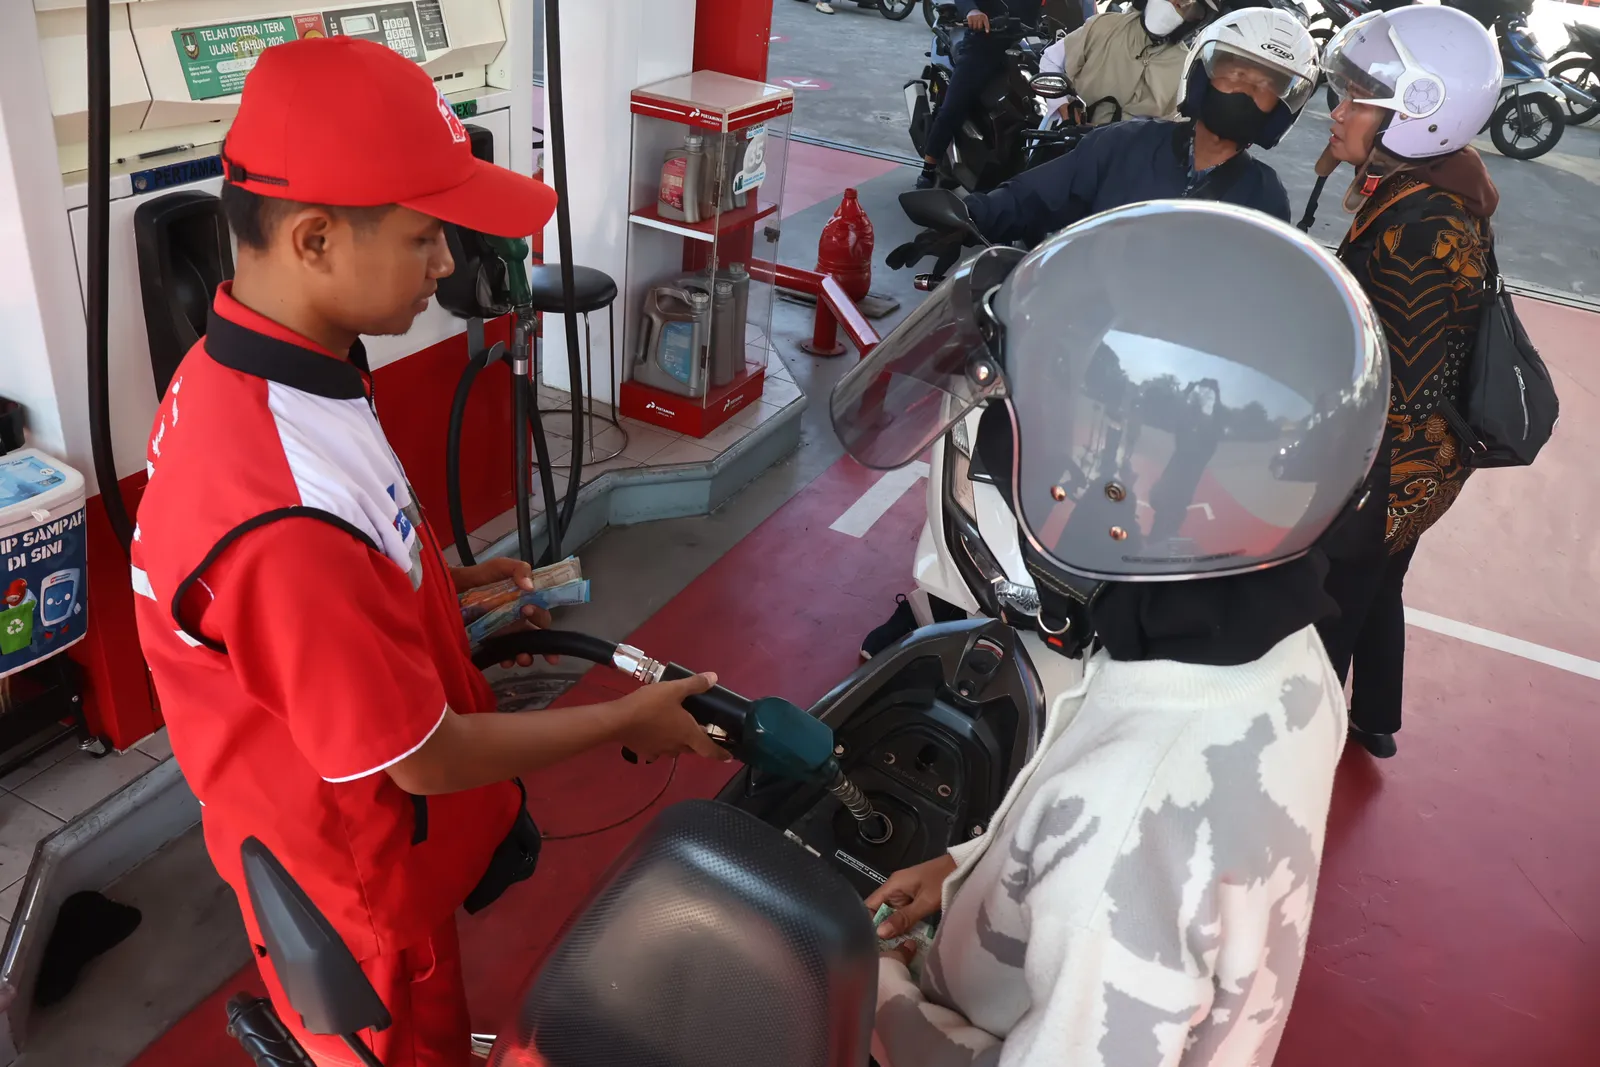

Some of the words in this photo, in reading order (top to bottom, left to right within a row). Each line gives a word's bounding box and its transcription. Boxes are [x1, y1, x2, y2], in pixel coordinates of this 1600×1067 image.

[200, 28, 229, 42] TELAH
[229, 25, 260, 38] DITERA
[264, 21, 285, 33] TERA
[208, 42, 238, 56] ULANG
[238, 38, 267, 52] TAHUN
[267, 36, 285, 48] 2025
[154, 160, 222, 187] PERTAMA
[655, 405, 675, 416] PERTAMINA
[7, 552, 27, 572] DI
[30, 539, 63, 563] SINI
